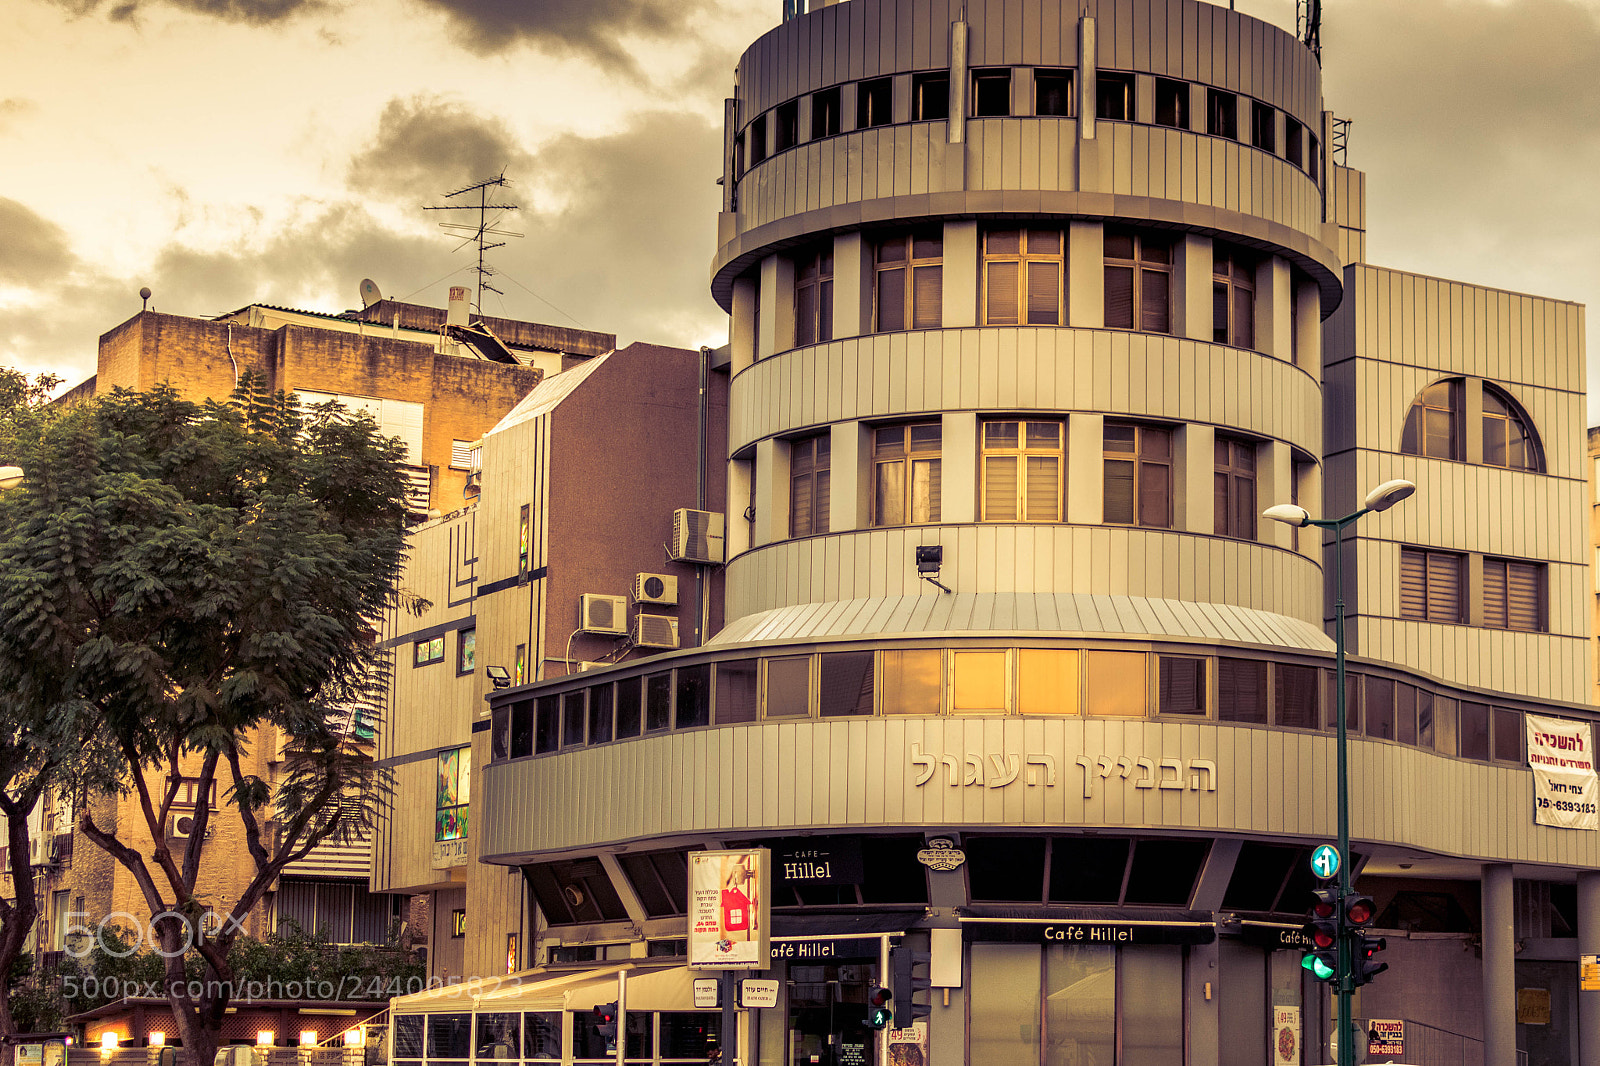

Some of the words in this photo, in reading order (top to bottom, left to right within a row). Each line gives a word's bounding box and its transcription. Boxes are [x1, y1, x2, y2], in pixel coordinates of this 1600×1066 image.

[1534, 732, 1584, 752] להשכרה
[911, 742, 1057, 789] העגול
[1560, 758, 1591, 770] משרדים
[1076, 755, 1217, 798] הבניין
[795, 851, 818, 859] CAFE
[783, 861, 832, 880] Hillel
[1044, 926, 1084, 941] Café
[1090, 927, 1134, 942] Hillel
[1280, 930, 1301, 944] Café
[771, 943, 794, 958] afé
[798, 942, 835, 957] Hillel
[1376, 1021, 1403, 1031] להשכרה
